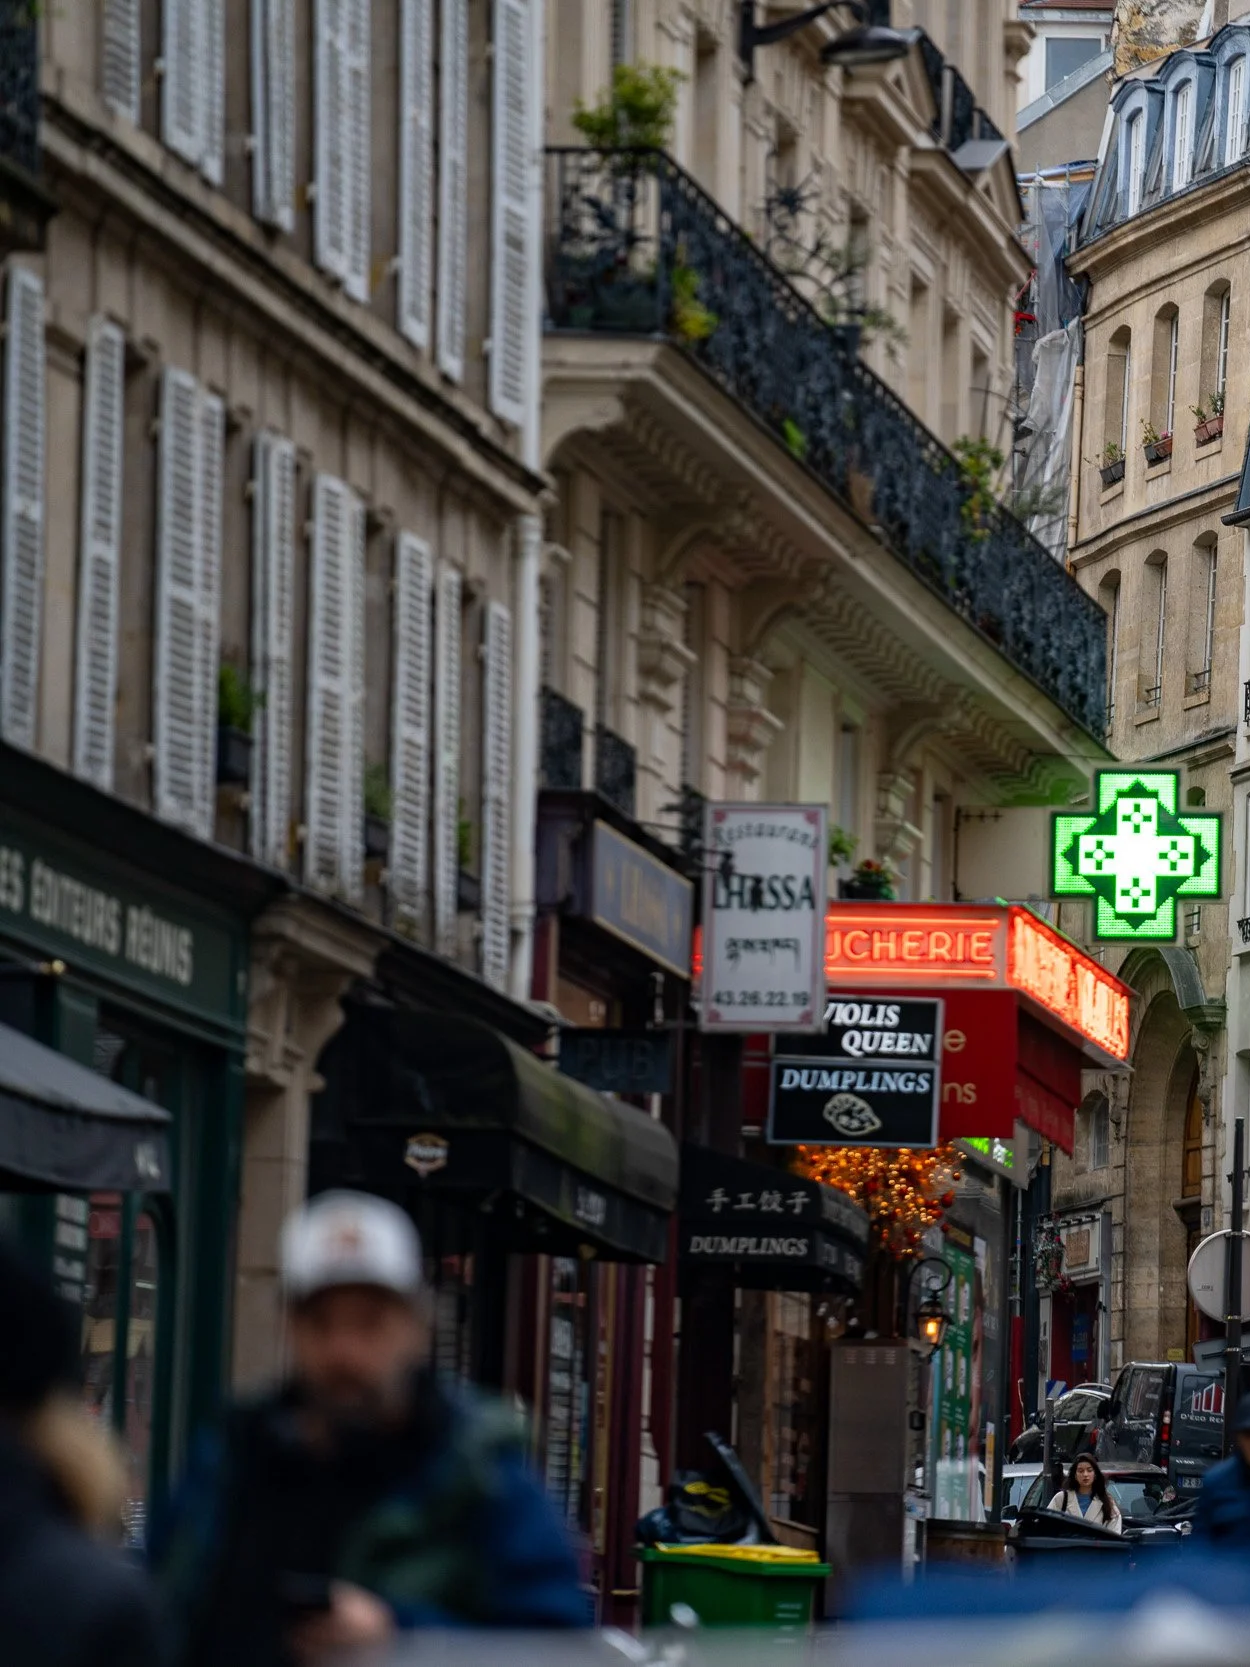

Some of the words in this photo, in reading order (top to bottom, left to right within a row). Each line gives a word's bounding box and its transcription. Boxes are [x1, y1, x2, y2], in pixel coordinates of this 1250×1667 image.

[711, 873, 816, 911] LHSSA
[841, 1030, 933, 1057] QUEEN
[780, 1068, 931, 1094] DUMPLINGS
[689, 1235, 809, 1257] DUMPLINGS
